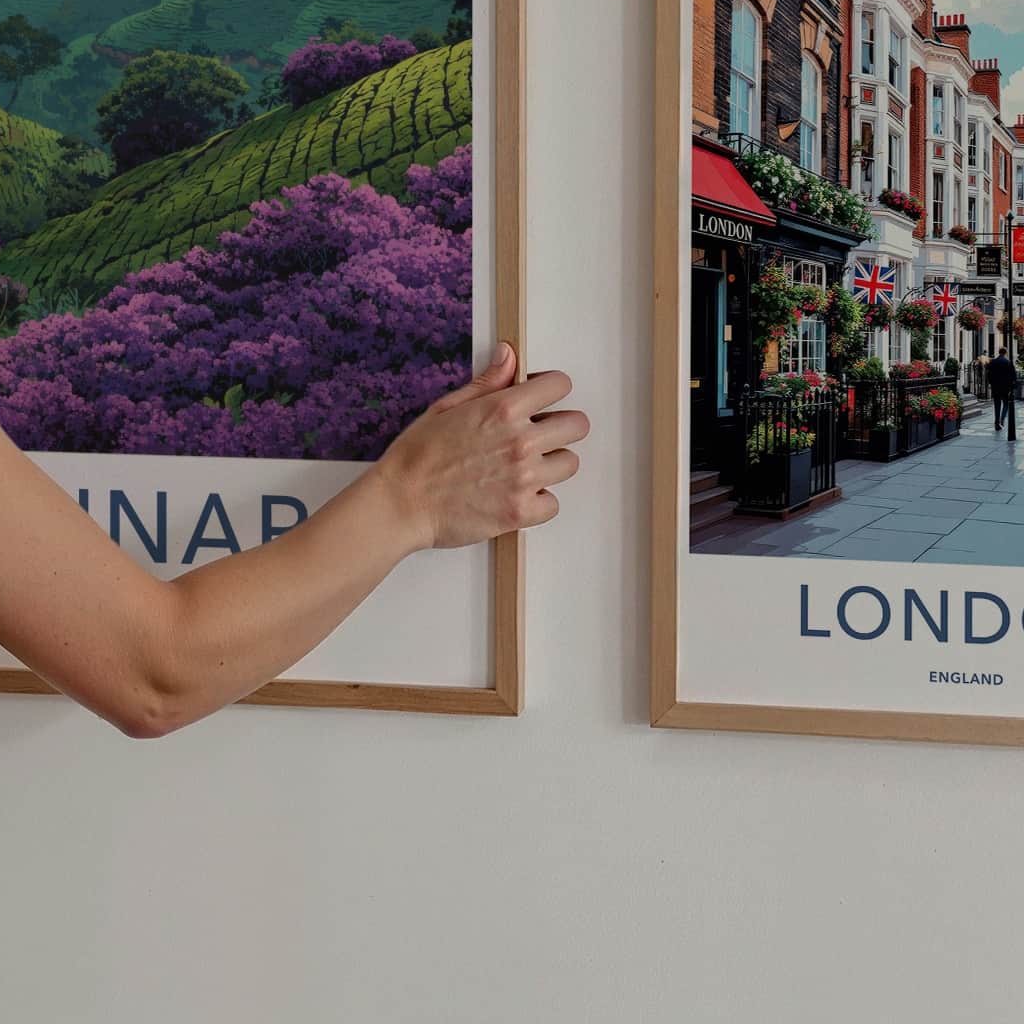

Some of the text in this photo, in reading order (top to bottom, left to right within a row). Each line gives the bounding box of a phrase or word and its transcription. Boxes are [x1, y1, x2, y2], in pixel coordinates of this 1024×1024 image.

[698, 213, 753, 242] LONDON
[800, 584, 1024, 645] LOND
[929, 671, 1004, 686] ENGLAND
